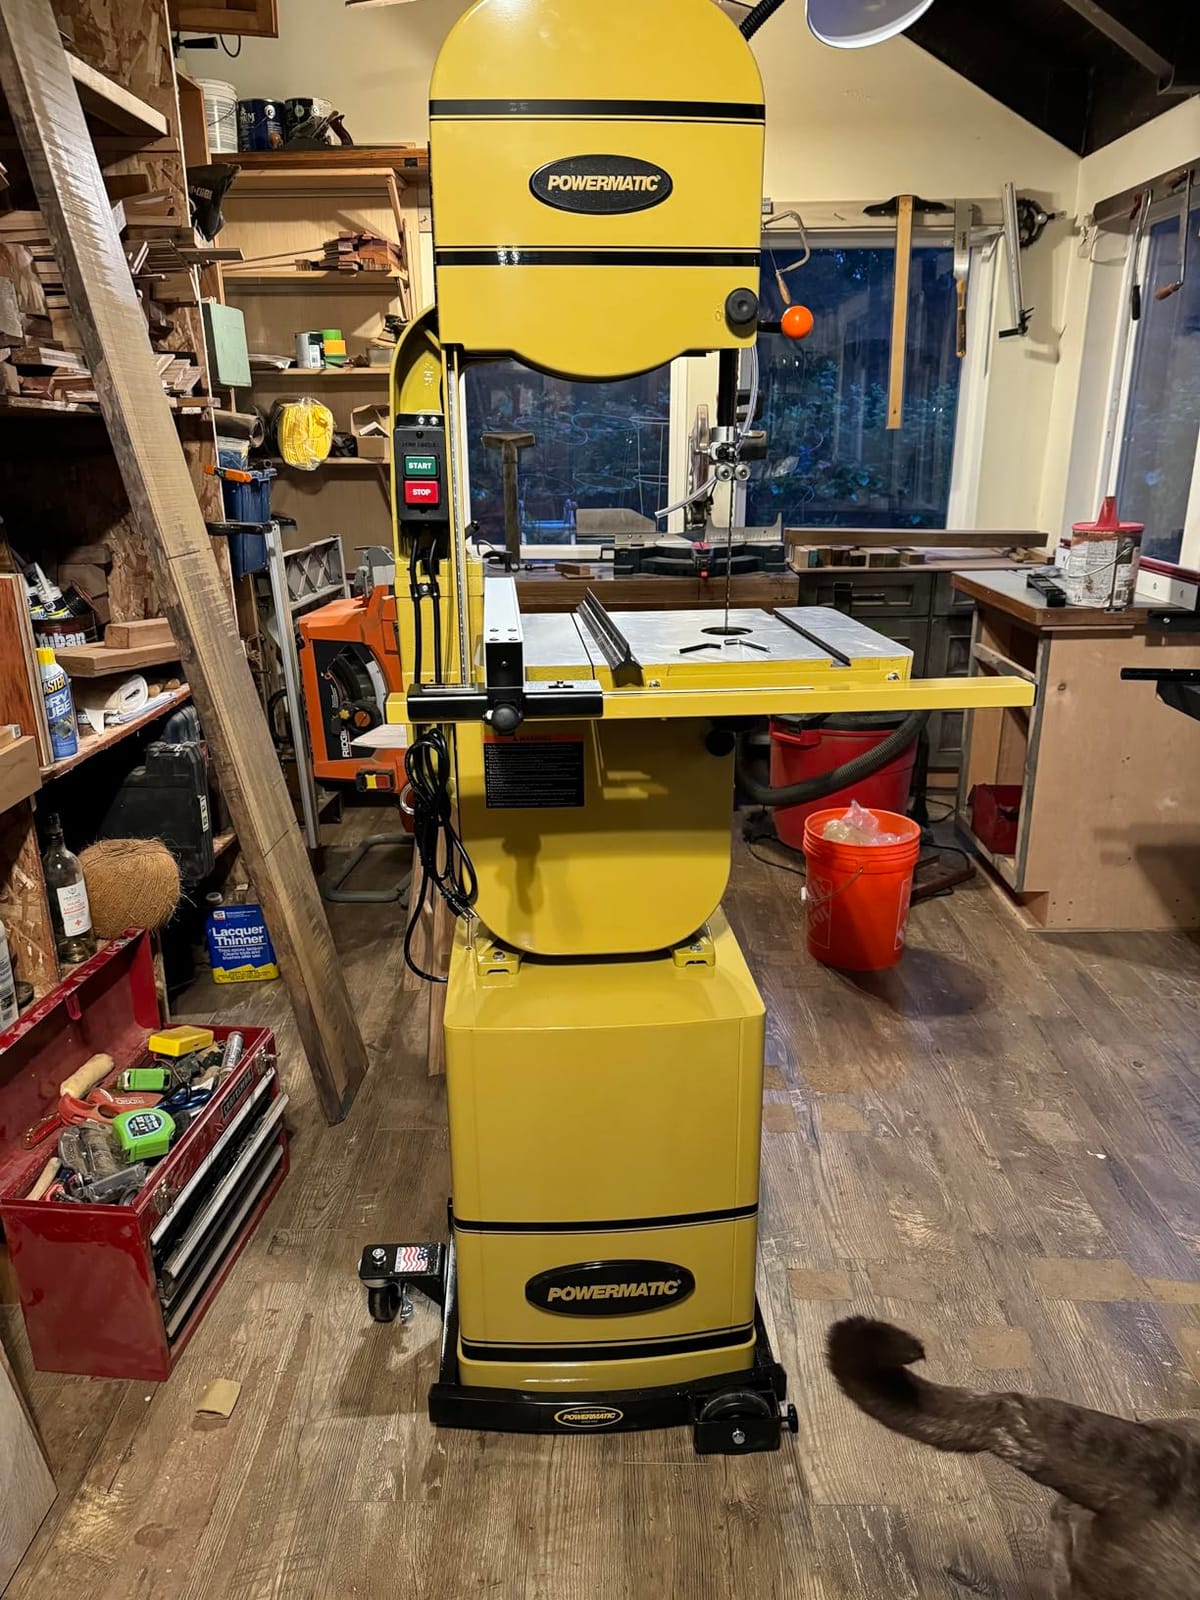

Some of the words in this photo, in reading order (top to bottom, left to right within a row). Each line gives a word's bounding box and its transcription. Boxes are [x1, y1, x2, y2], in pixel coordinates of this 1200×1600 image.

[547, 175, 660, 191] POWERMATIC
[408, 462, 432, 470] START
[412, 488, 432, 496] STOP
[48, 701, 72, 719] UBE
[212, 926, 264, 937] Lacquer
[214, 935, 264, 946] Thinner
[547, 1280, 681, 1302] POWERMATIC
[563, 1412, 617, 1421] POWERMATIC
